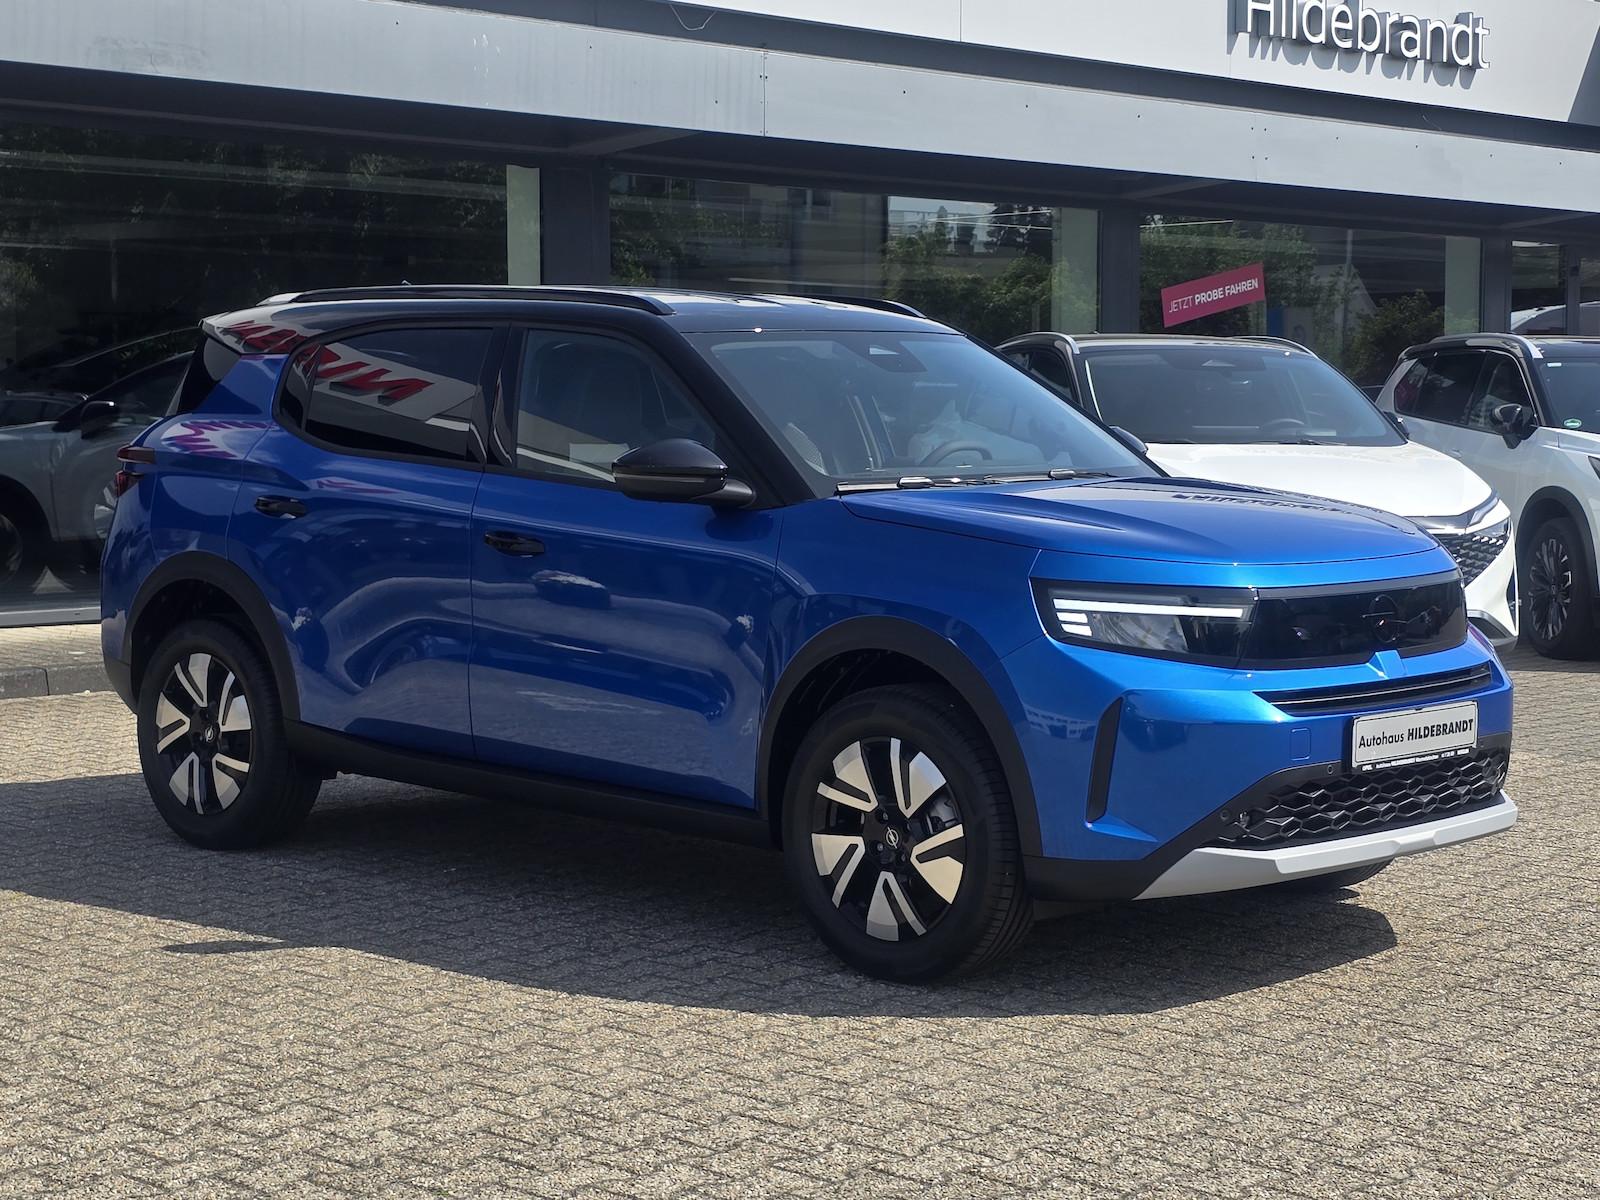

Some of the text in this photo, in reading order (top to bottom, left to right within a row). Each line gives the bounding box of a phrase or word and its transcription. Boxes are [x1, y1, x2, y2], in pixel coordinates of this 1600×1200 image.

[1247, 0, 1491, 69] Hildebrandt
[1168, 278, 1259, 313] JETZT PROBE FAHREN
[1358, 718, 1474, 749] Autohaus HILDEBRANDT
